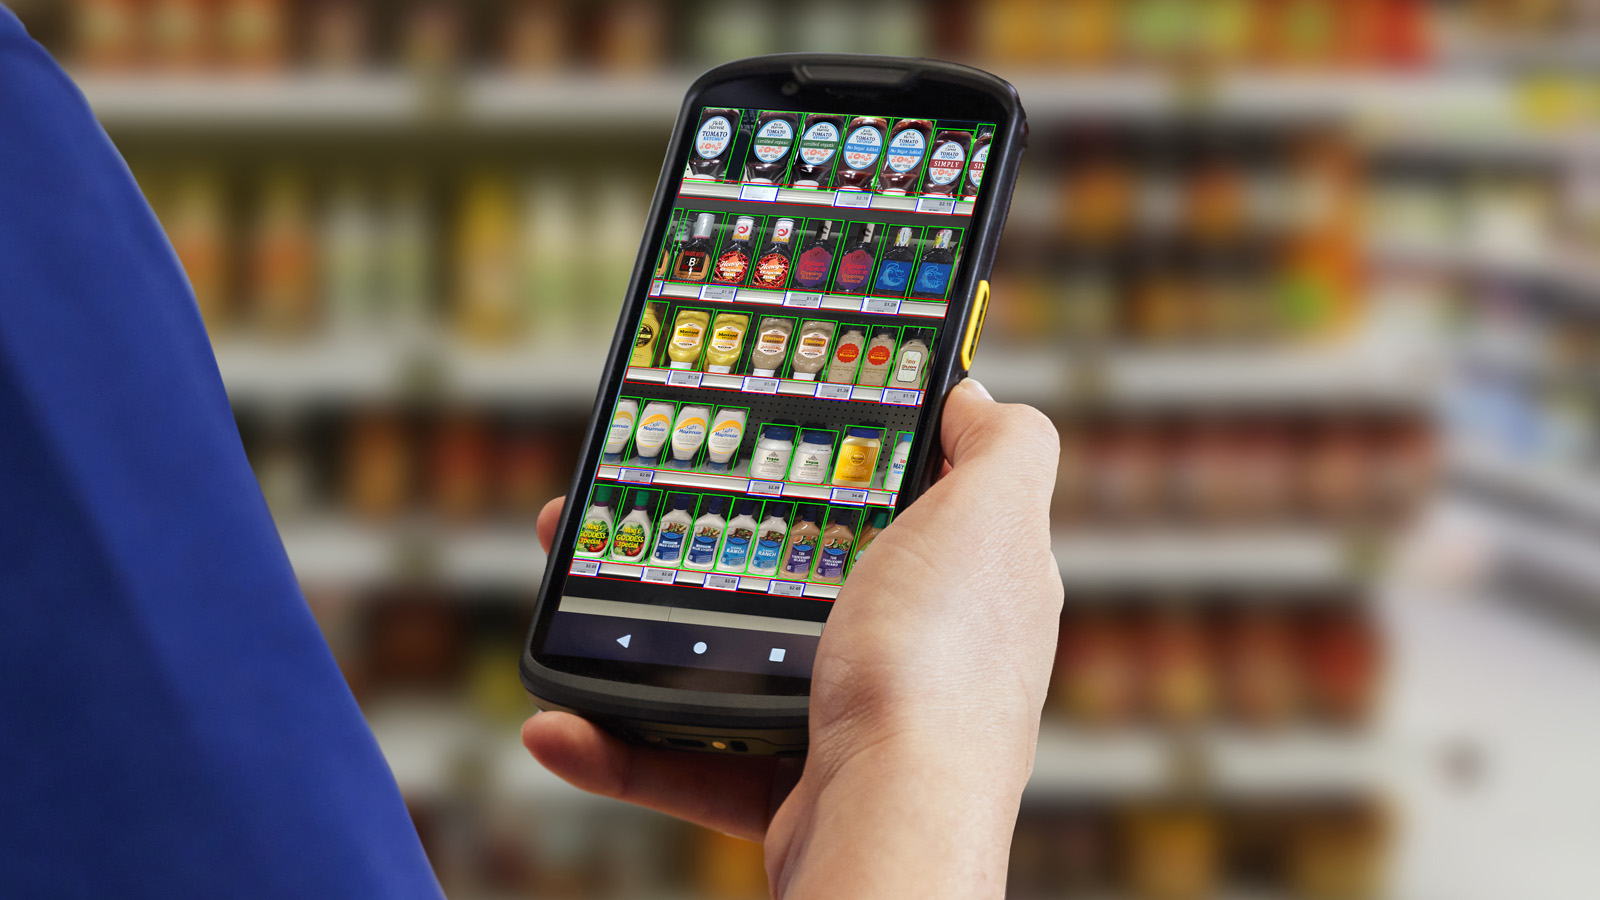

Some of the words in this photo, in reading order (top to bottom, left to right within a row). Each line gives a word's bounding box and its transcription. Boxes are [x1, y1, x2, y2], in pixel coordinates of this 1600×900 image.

[586, 522, 602, 532] Mag's
[624, 526, 640, 535] Mag's
[580, 536, 600, 544] special
[616, 534, 644, 542] GODDESS
[618, 540, 638, 548] special
